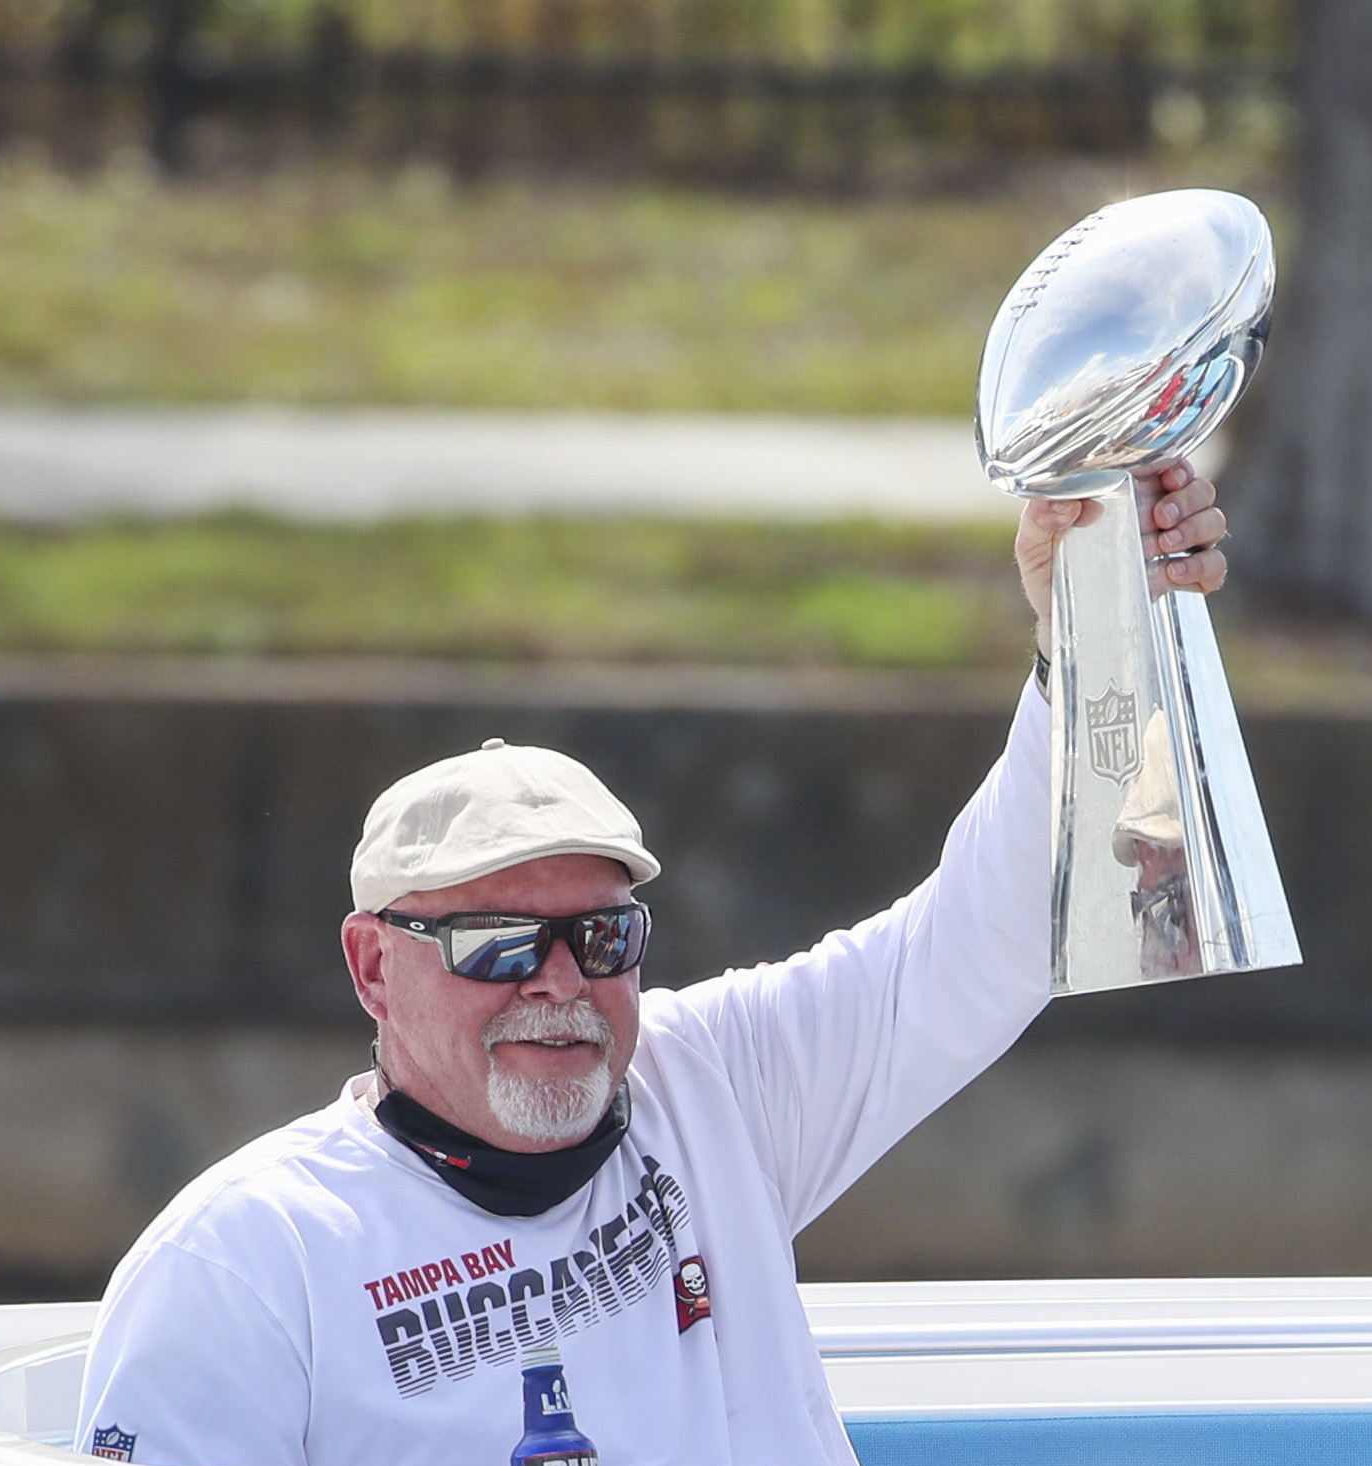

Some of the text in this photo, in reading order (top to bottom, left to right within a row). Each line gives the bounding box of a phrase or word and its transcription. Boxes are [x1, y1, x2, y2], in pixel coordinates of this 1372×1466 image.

[1093, 726, 1136, 773] NFL
[364, 1239, 517, 1311] TAMPA BAY
